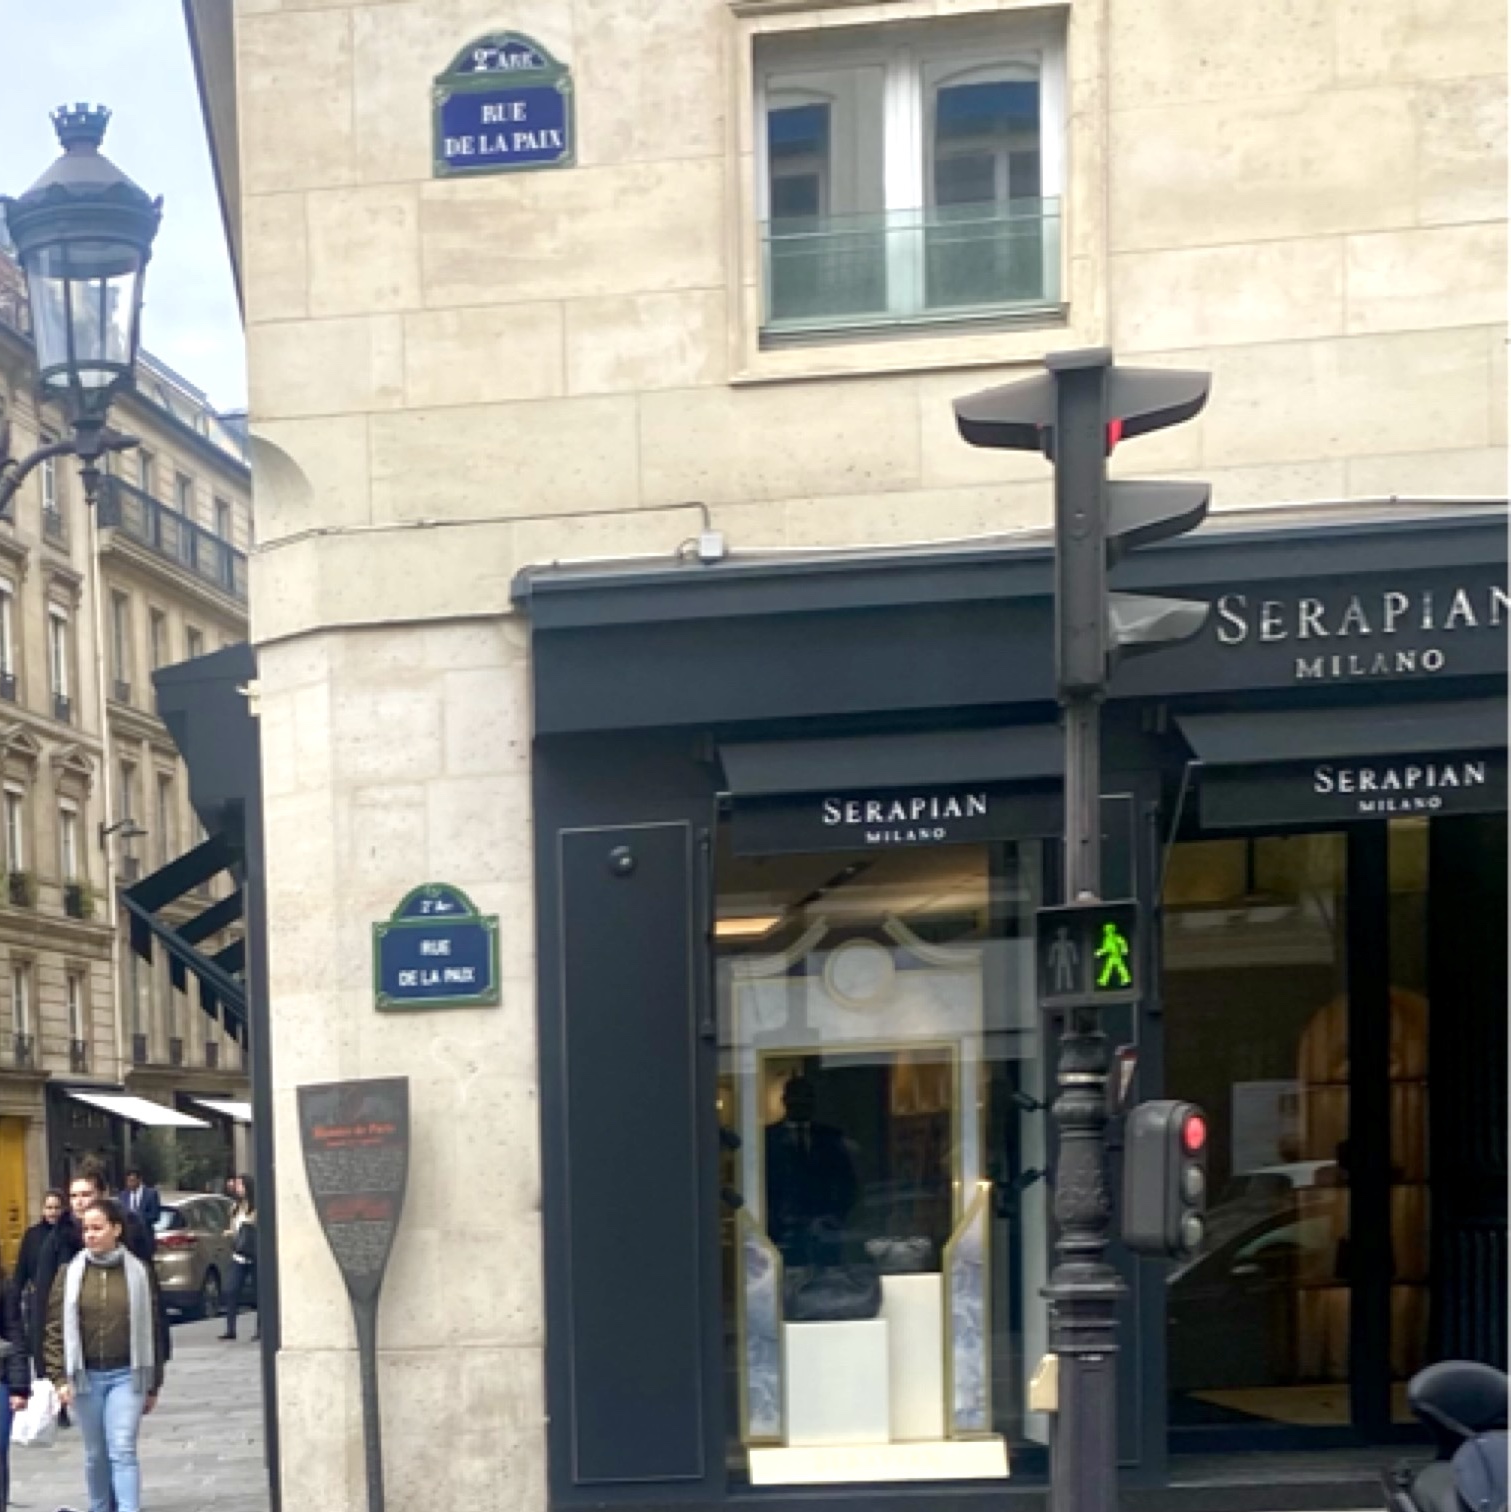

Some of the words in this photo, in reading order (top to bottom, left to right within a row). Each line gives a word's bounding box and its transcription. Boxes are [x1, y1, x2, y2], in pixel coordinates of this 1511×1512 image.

[481, 102, 527, 124] RUE
[444, 136, 476, 158] DE
[479, 133, 509, 154] LA
[512, 129, 564, 152] PAIX
[1295, 648, 1445, 679] MILANO
[1313, 761, 1486, 794] SERAPIAN
[822, 794, 988, 826] SERAPIAN
[1358, 795, 1443, 812] MILANO
[865, 827, 947, 844] MILANO
[419, 939, 452, 956] RUE
[398, 969, 419, 987] DE
[419, 969, 441, 987] LA
[443, 966, 476, 983] PAIX
